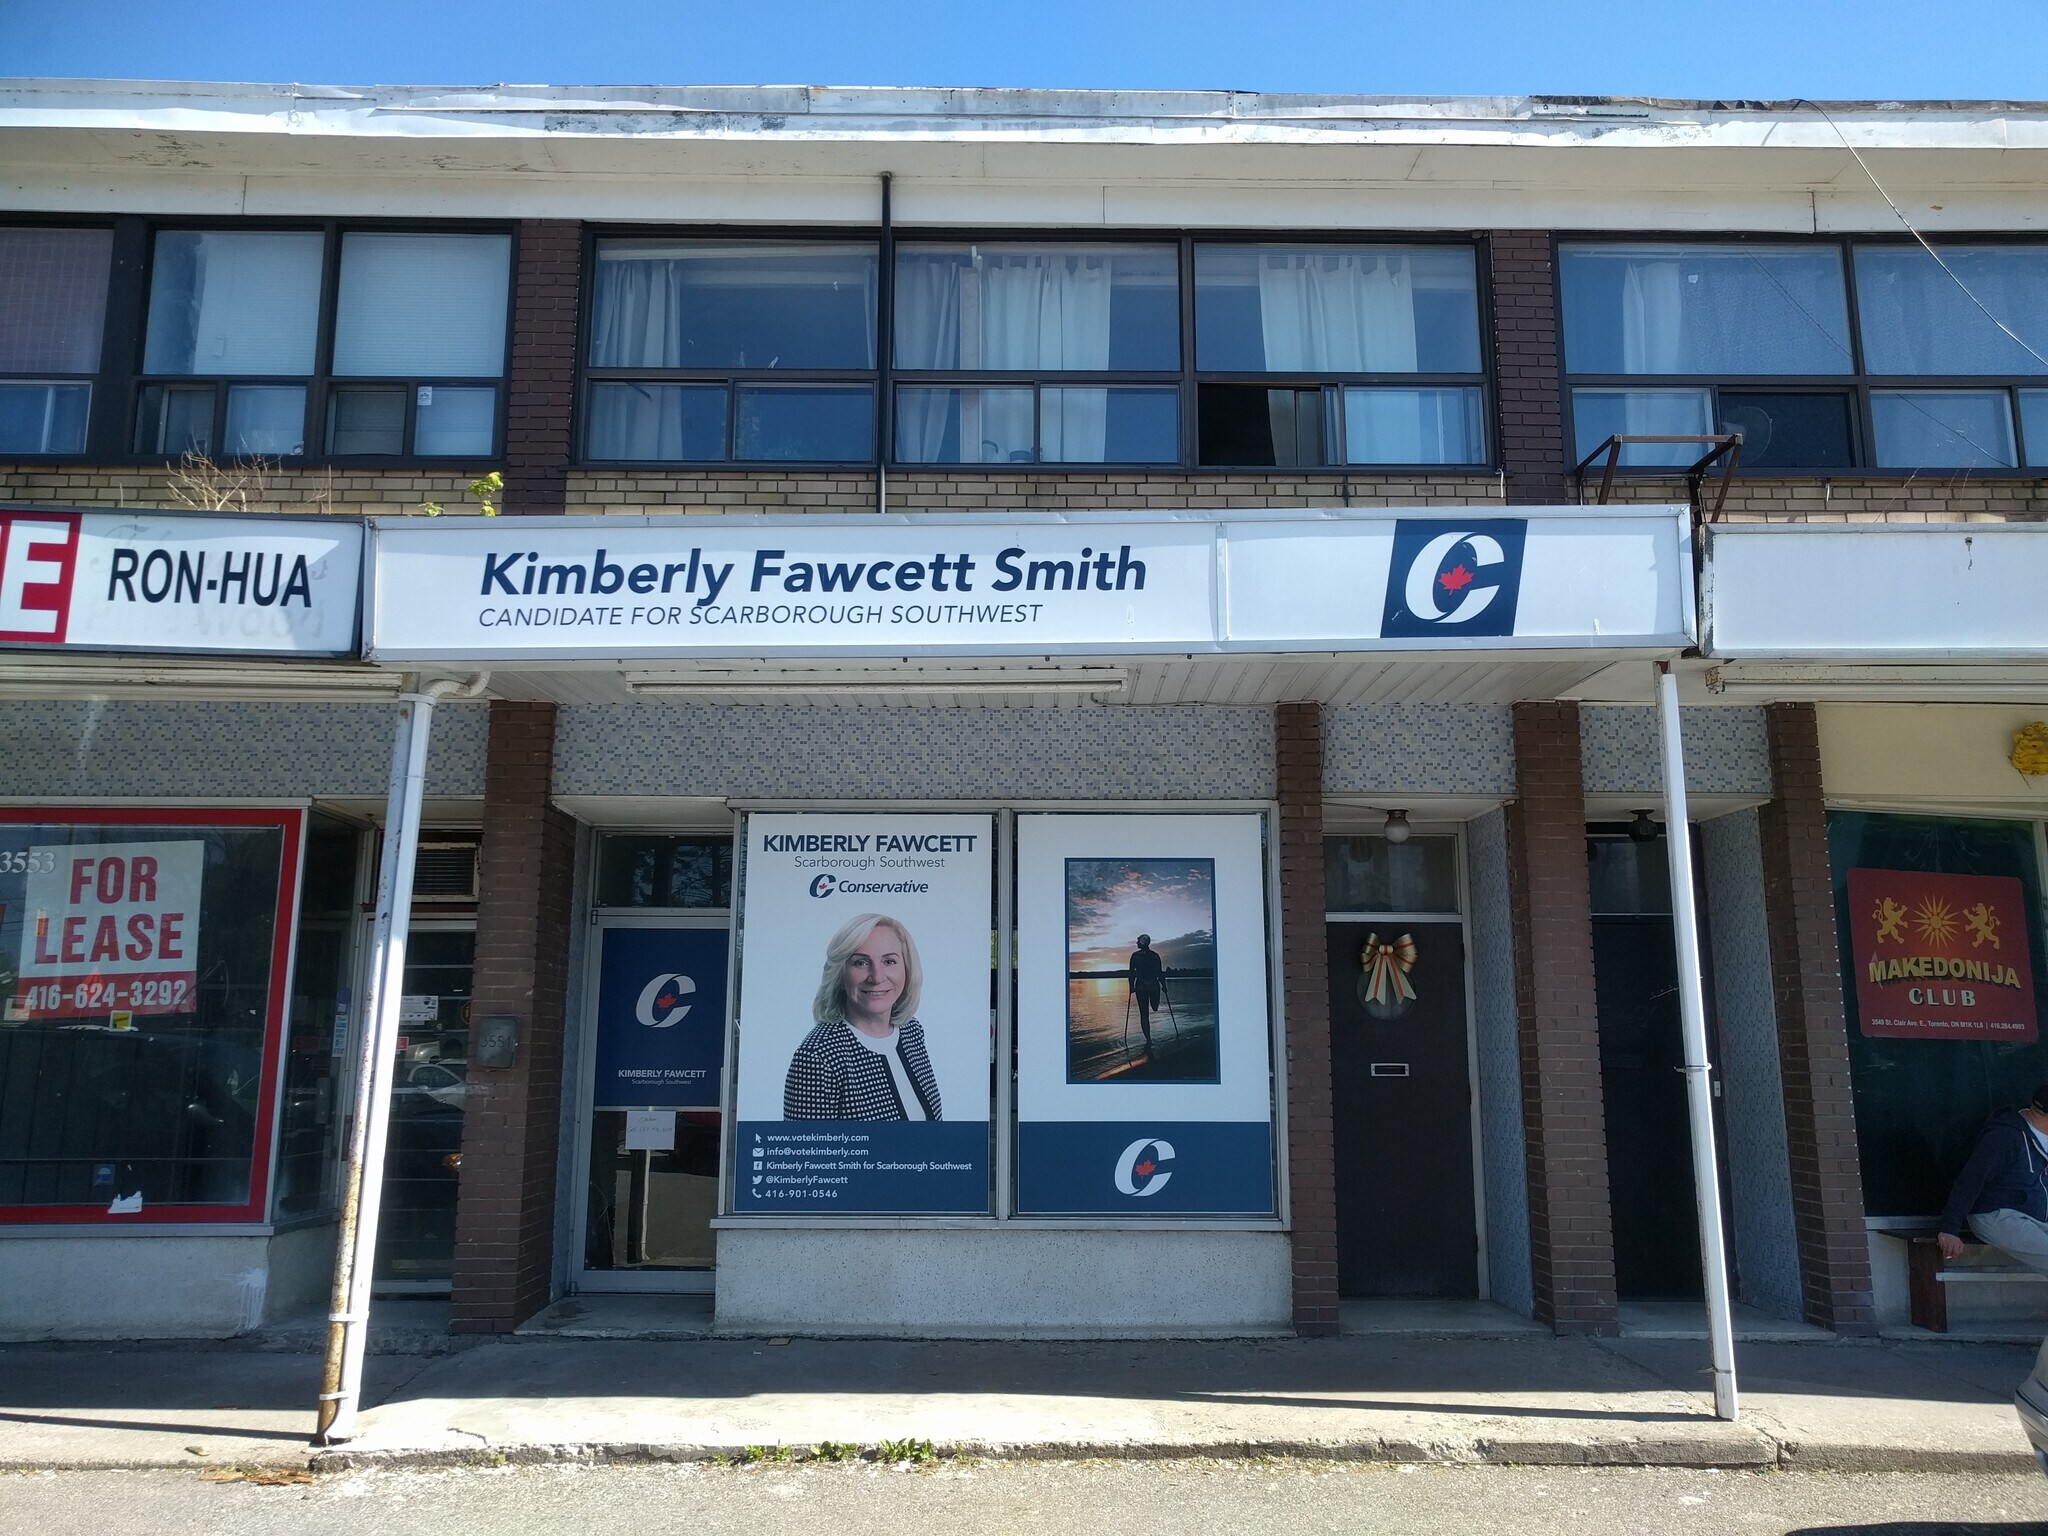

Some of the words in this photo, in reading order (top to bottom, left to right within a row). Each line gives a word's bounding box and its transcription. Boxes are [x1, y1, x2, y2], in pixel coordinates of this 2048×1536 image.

[107, 547, 312, 608] RON-HUA
[480, 547, 735, 607] Kimberly
[750, 549, 976, 593] Fawcett
[990, 545, 1147, 592] Smith
[479, 607, 624, 627] CANDIDATE
[631, 606, 682, 626] FOR
[689, 604, 883, 625] SCARBOROUGH
[890, 604, 1044, 624] SOUTHWEST
[763, 834, 871, 852] KIMBERLY
[875, 834, 978, 853] FAWCETT
[0, 851, 56, 874] 3553
[794, 855, 876, 871] Scarborough
[879, 855, 946, 868] Southwest
[69, 856, 158, 905] FOR
[838, 879, 929, 893] Conservative
[34, 912, 185, 965] LEASE
[1868, 956, 2021, 989] MAKEDONIJA
[26, 979, 187, 1010] 416-624-3292
[1908, 987, 1976, 1007] CLUB
[1893, 1019, 1906, 1027] Clair
[1927, 1020, 1950, 1029] Toronto,
[618, 1069, 663, 1078] KIMBERLY
[664, 1069, 707, 1079] FAWCETT
[766, 1133, 870, 1144] www.votekimberly.com
[766, 1147, 869, 1158] info@votekimberly.com
[766, 1161, 803, 1172] Kimberly
[804, 1161, 837, 1170] Fawcett
[838, 1161, 862, 1170] Smith
[863, 1160, 875, 1170] for
[876, 1161, 928, 1172] Scarborough
[929, 1161, 972, 1170] Southwest
[765, 1175, 849, 1186] @KimberlyFawcett
[765, 1189, 838, 1198] 416-901-0546
